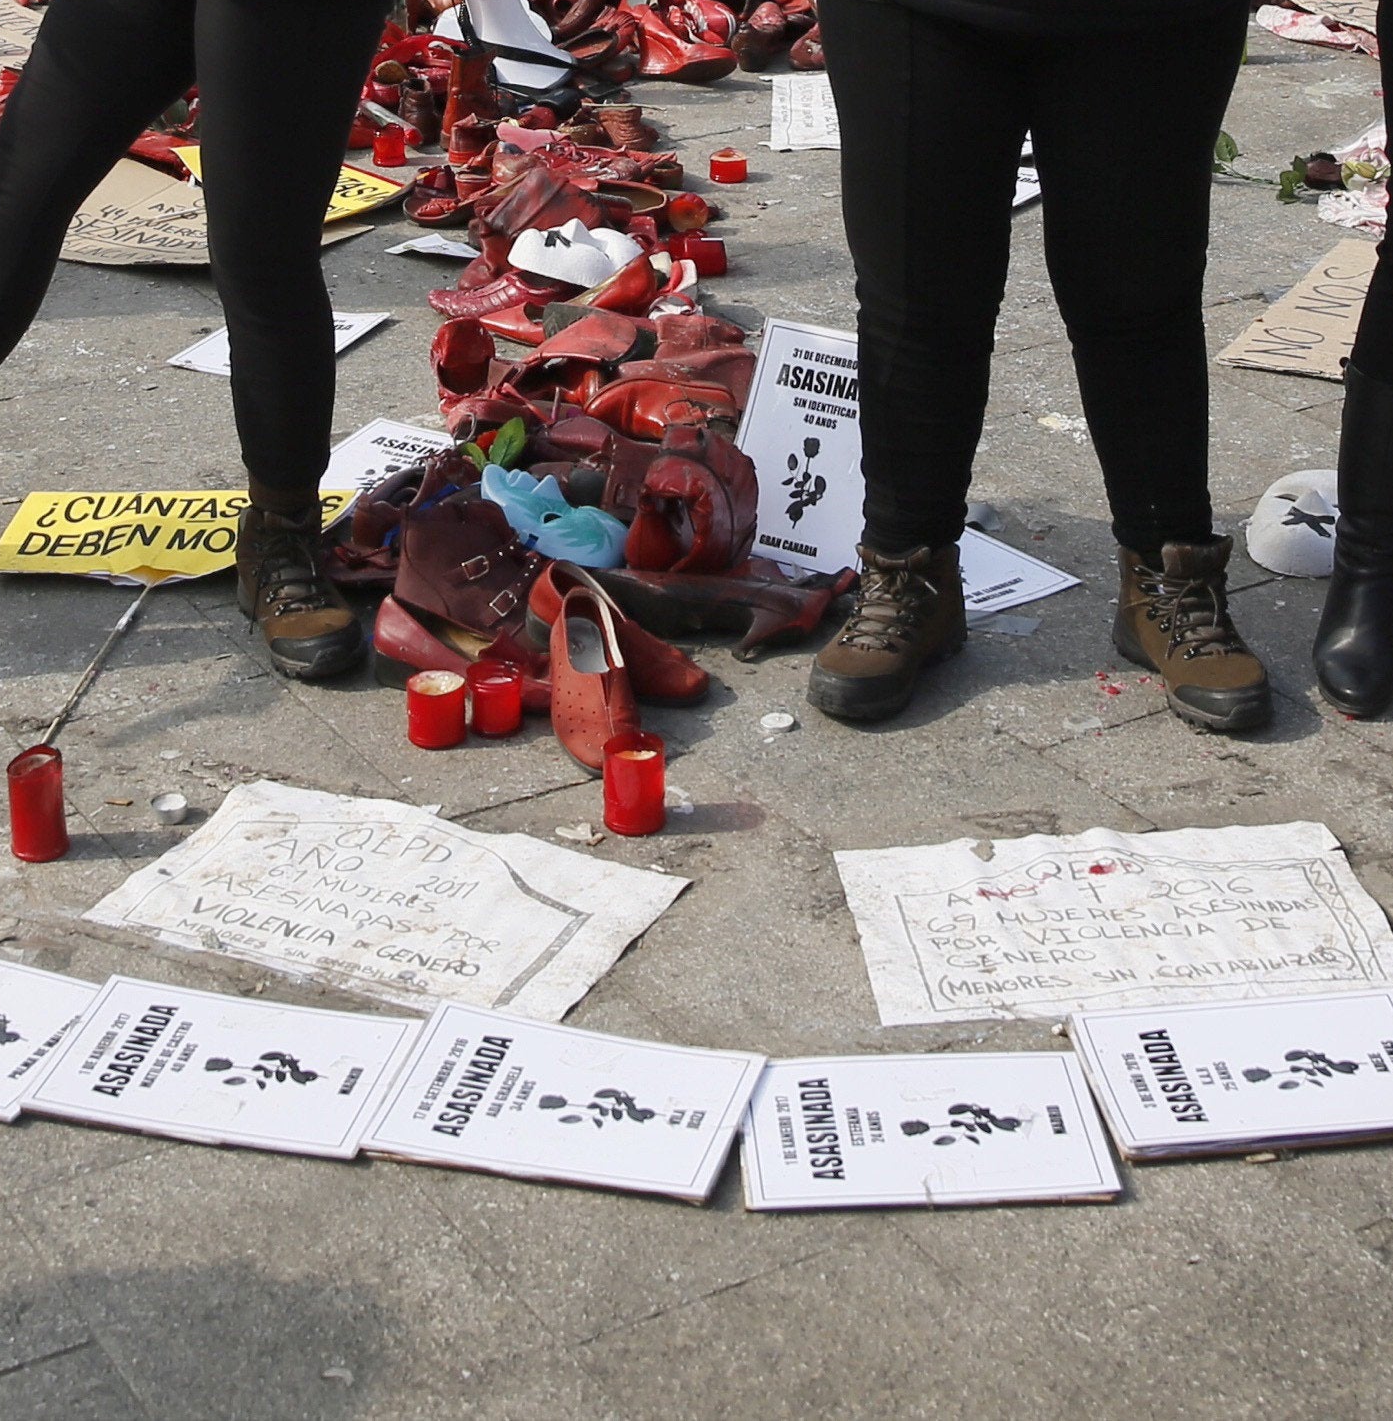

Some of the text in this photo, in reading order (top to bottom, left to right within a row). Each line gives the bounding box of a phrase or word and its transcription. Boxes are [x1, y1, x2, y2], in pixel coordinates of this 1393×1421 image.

[1244, 267, 1373, 360] NO NOS
[793, 347, 858, 370] 31 DE DECEMBRO
[793, 396, 857, 419] SIN IDENTIFICAR
[803, 413, 837, 430] 40 ANOS
[37, 493, 244, 528] ¿CUÁNTAS
[17, 524, 165, 557] DEBEN
[759, 534, 818, 557] GRAN CANARIA
[335, 828, 452, 864] QEPD
[264, 839, 480, 899] AÑO 2011
[313, 876, 437, 914] MUJERES
[1150, 877, 1255, 900] 2016
[192, 896, 335, 947] VIOLENCIA
[207, 875, 500, 954] ASESINADAS POR
[927, 896, 1319, 935] 69 MUJERES ASESINADAS
[928, 916, 1291, 950] POR VIOLENCIA DE
[1093, 968, 1138, 982] SIN
[92, 1005, 180, 1097] ASASINADA
[432, 1036, 513, 1137] ASASINADA
[1138, 1028, 1209, 1123] ASASINADA
[798, 1078, 845, 1180] ASASINADA
